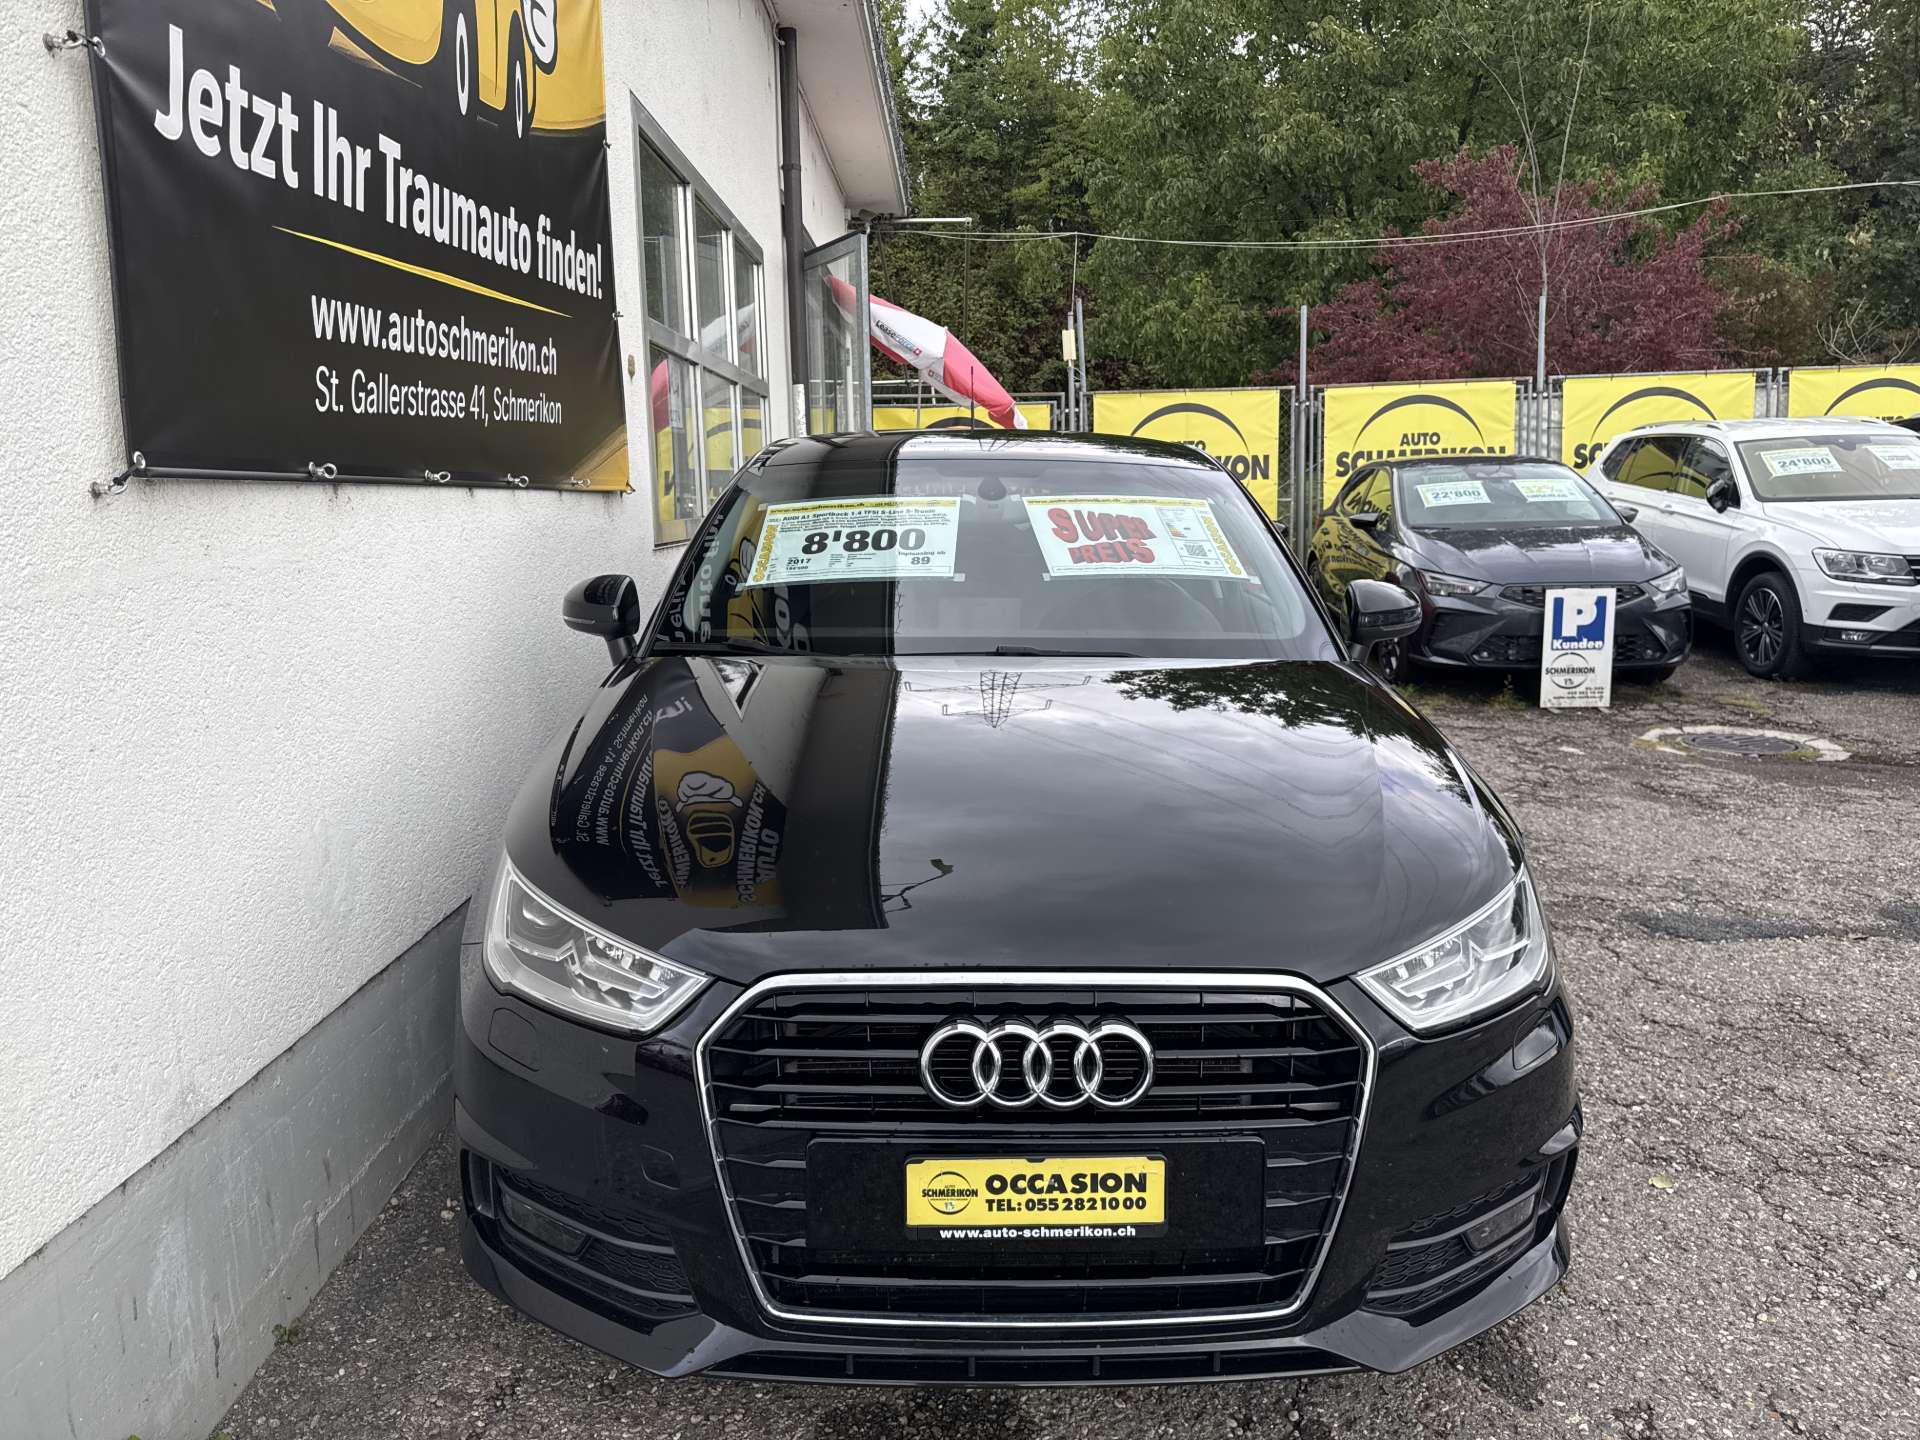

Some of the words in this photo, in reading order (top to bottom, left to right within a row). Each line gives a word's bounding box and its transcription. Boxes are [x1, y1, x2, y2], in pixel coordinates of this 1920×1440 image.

[154, 23, 299, 189] Jetzt
[313, 99, 371, 212] Ihr
[379, 133, 531, 273] Traumauto
[537, 213, 602, 299] finden!
[311, 294, 557, 376] www.autoschmerikon.ch
[315, 366, 344, 413] St.
[351, 367, 466, 419] Gallerstrasse
[469, 390, 489, 426] 41,
[492, 390, 562, 425] Schmerikon
[1400, 432, 1440, 446] AUTO
[1778, 457, 1831, 469] 24'800
[1431, 489, 1481, 499] 22'800
[1047, 508, 1157, 543] SUPER
[801, 528, 926, 555] 8'800
[911, 556, 931, 565] 89
[1553, 638, 1603, 649] Kunden
[1545, 667, 1595, 675] SCHMERIKON
[985, 1173, 1147, 1195] OCCASION
[922, 1188, 978, 1198] SCHMERIKON
[985, 1199, 1022, 1212] TEL:
[1025, 1198, 1059, 1211] 055
[940, 1226, 1136, 1239] www.auto-schmerikon.ch
